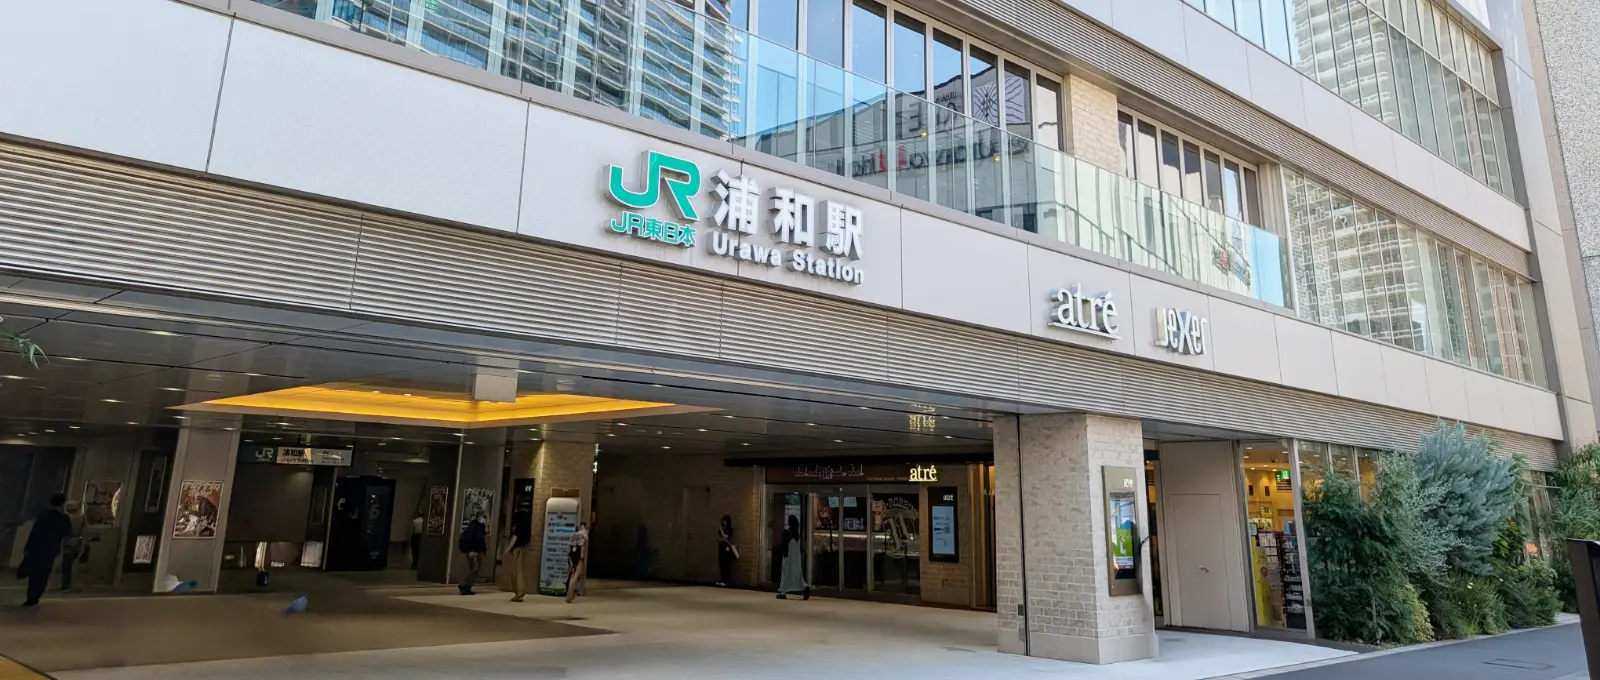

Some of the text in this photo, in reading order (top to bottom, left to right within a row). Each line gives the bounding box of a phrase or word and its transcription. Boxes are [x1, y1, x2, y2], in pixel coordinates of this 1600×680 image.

[608, 149, 701, 221] JR
[609, 211, 697, 247] JR東日本
[709, 168, 864, 259] 浦和駅
[711, 230, 864, 284] Urawa Station
[1055, 282, 1120, 335] atré
[909, 465, 938, 481] atré
